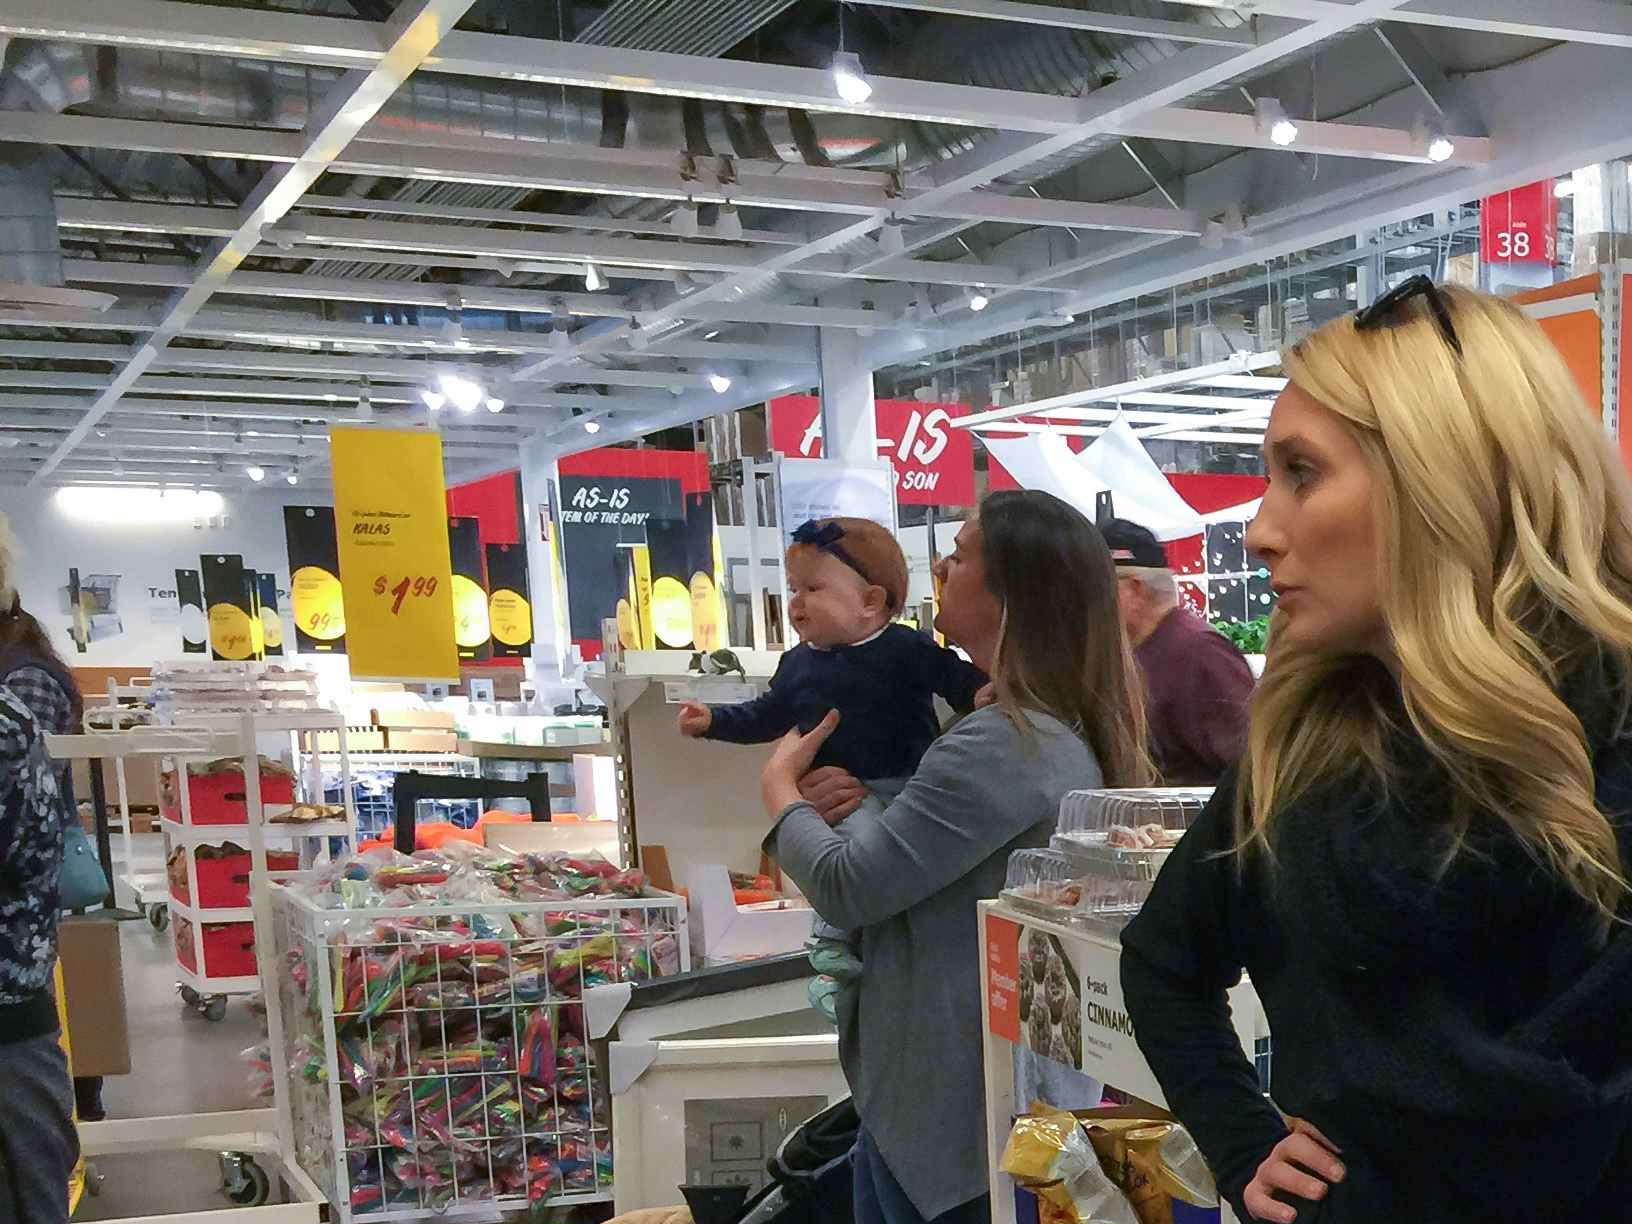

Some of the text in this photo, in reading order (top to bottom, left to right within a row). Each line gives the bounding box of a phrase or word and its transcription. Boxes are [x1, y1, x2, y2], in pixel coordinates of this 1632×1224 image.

[1496, 232, 1530, 257] 38
[902, 471, 939, 490] SON
[572, 487, 630, 509] AS-IS
[560, 510, 650, 525] TEM OF THE DAY!
[353, 523, 390, 535] KALAS
[1087, 1001, 1134, 1037] CINNAMO
